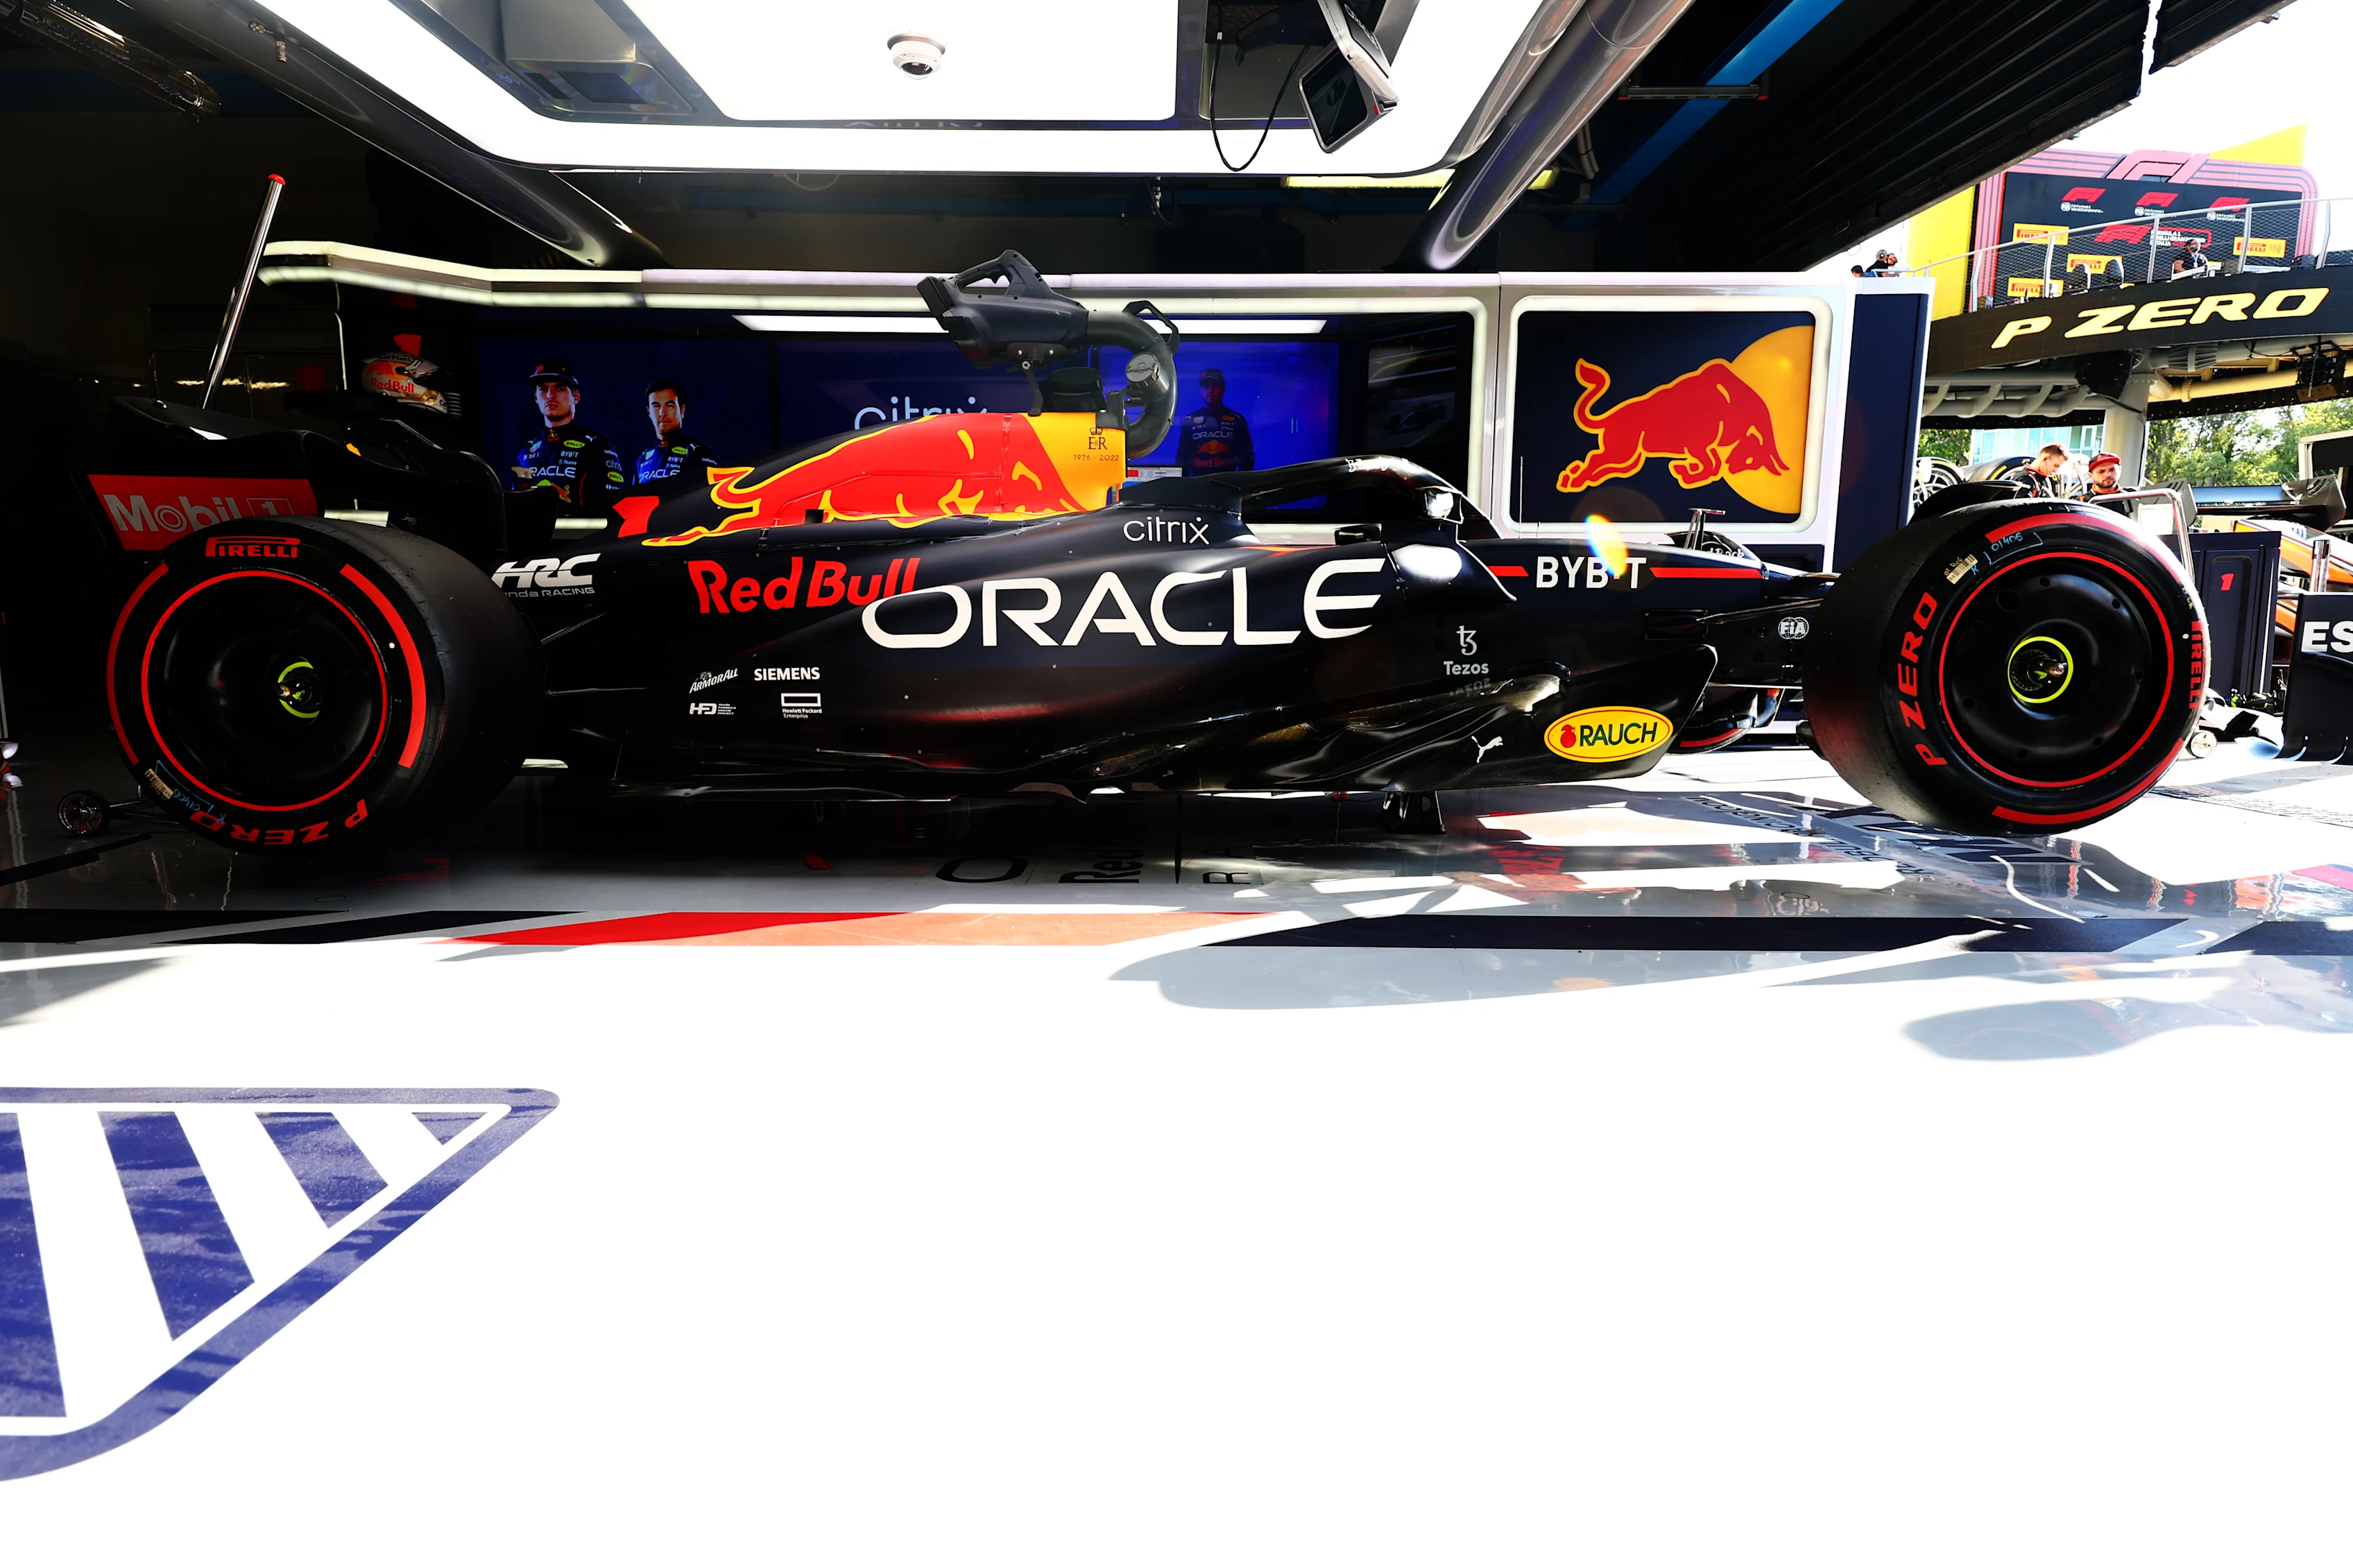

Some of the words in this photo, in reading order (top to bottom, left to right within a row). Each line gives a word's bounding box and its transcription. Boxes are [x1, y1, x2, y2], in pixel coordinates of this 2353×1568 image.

[1991, 316, 2053, 349] P
[2064, 287, 2330, 338] ZERO
[103, 494, 242, 532] Mobil
[1123, 516, 1210, 545] citrix
[205, 535, 300, 558] PIRELLI
[490, 553, 601, 589] HRC
[687, 557, 803, 614] Red
[806, 557, 921, 608] Bull
[2221, 573, 2234, 591] 1
[541, 587, 595, 597] RACING
[862, 558, 1386, 649] ORACLE
[753, 667, 821, 681] SIEMENS
[1444, 661, 1489, 675] Tezos
[1897, 592, 1938, 731] ZERO
[1579, 723, 1657, 747] RAUCH
